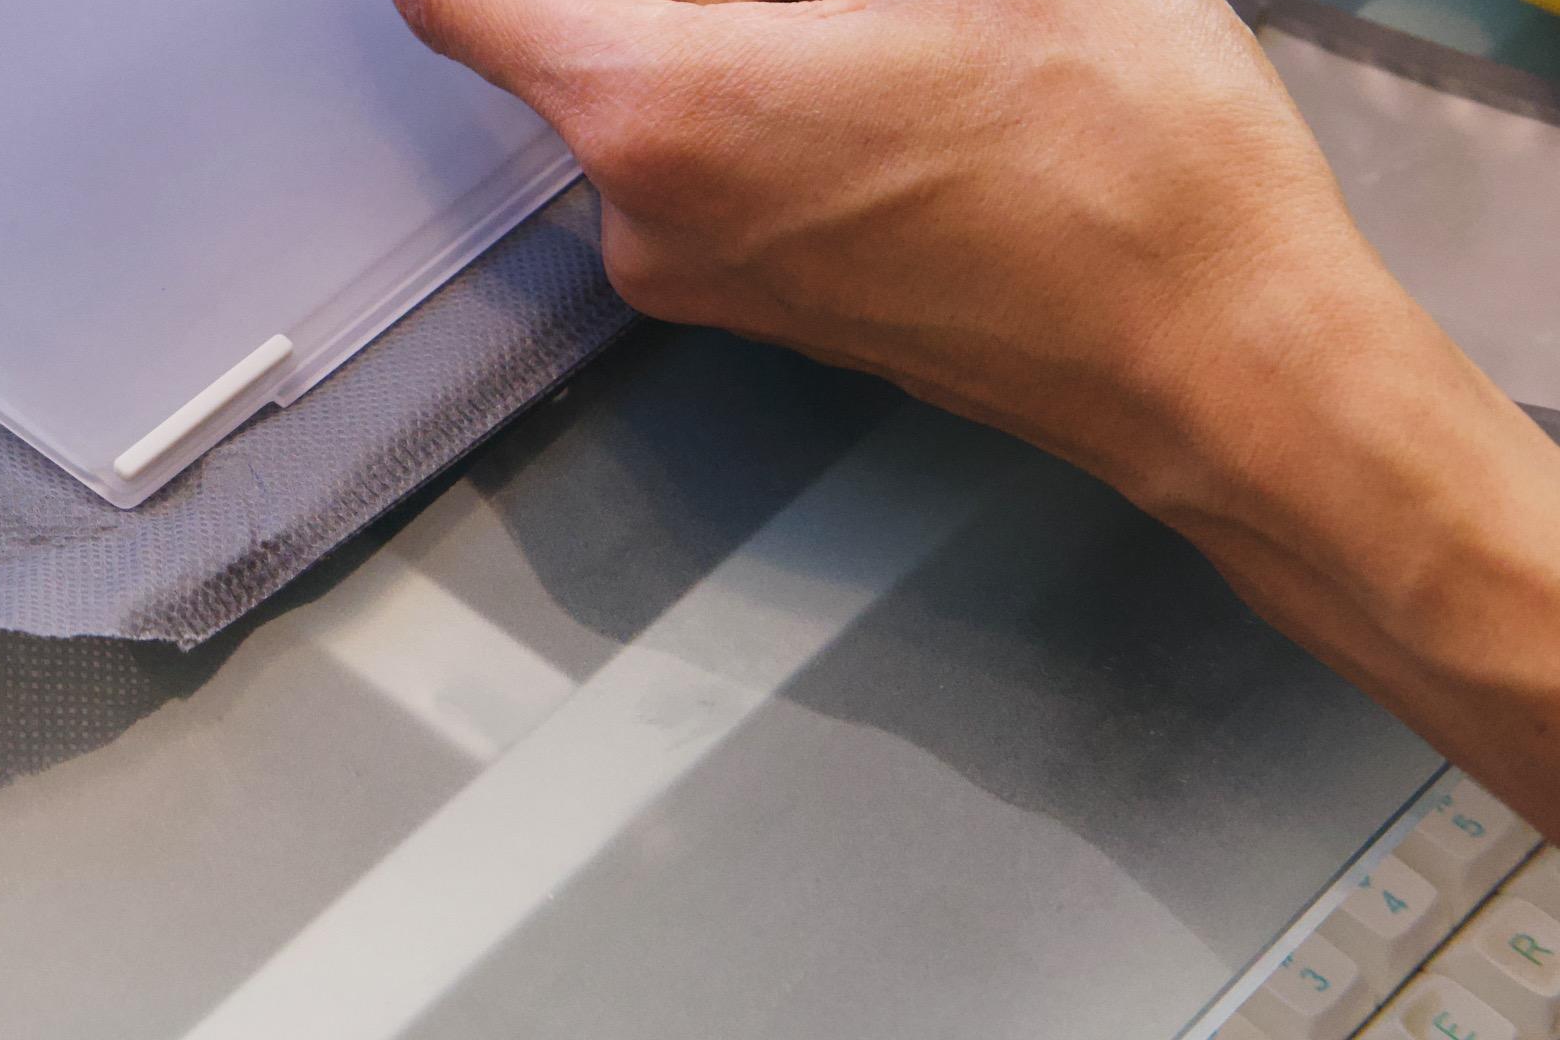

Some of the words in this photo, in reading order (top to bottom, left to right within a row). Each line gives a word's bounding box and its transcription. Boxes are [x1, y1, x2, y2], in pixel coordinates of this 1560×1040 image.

[1452, 814, 1485, 838] 5
[1383, 890, 1409, 913] 4
[1507, 932, 1554, 966] R
[1299, 968, 1332, 992] 3
